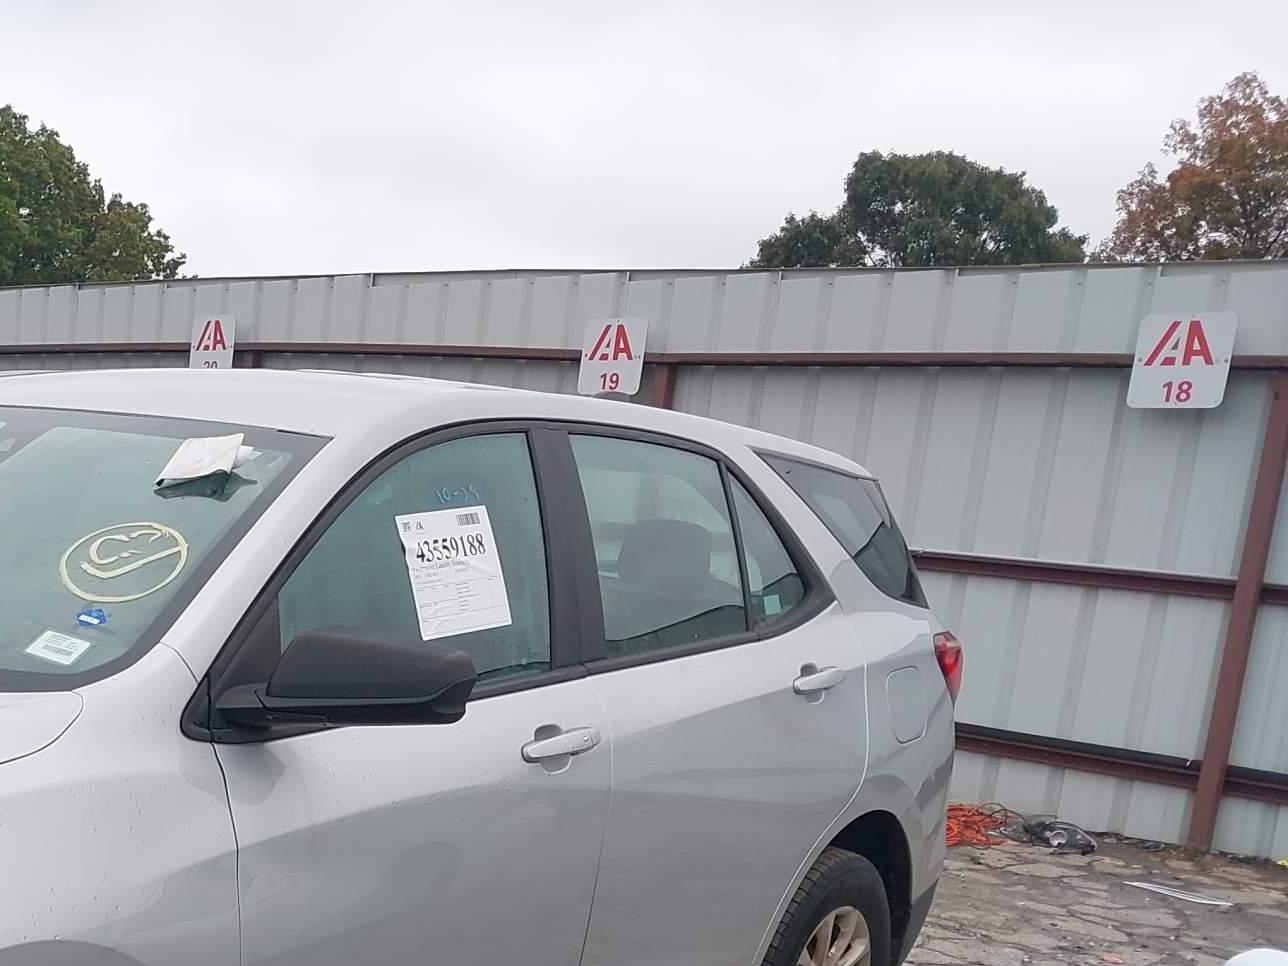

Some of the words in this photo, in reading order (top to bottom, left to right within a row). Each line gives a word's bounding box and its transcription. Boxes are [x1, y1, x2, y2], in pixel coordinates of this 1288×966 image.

[599, 372, 620, 390] 19
[1162, 381, 1193, 403] 18
[415, 532, 487, 563] 43559188
